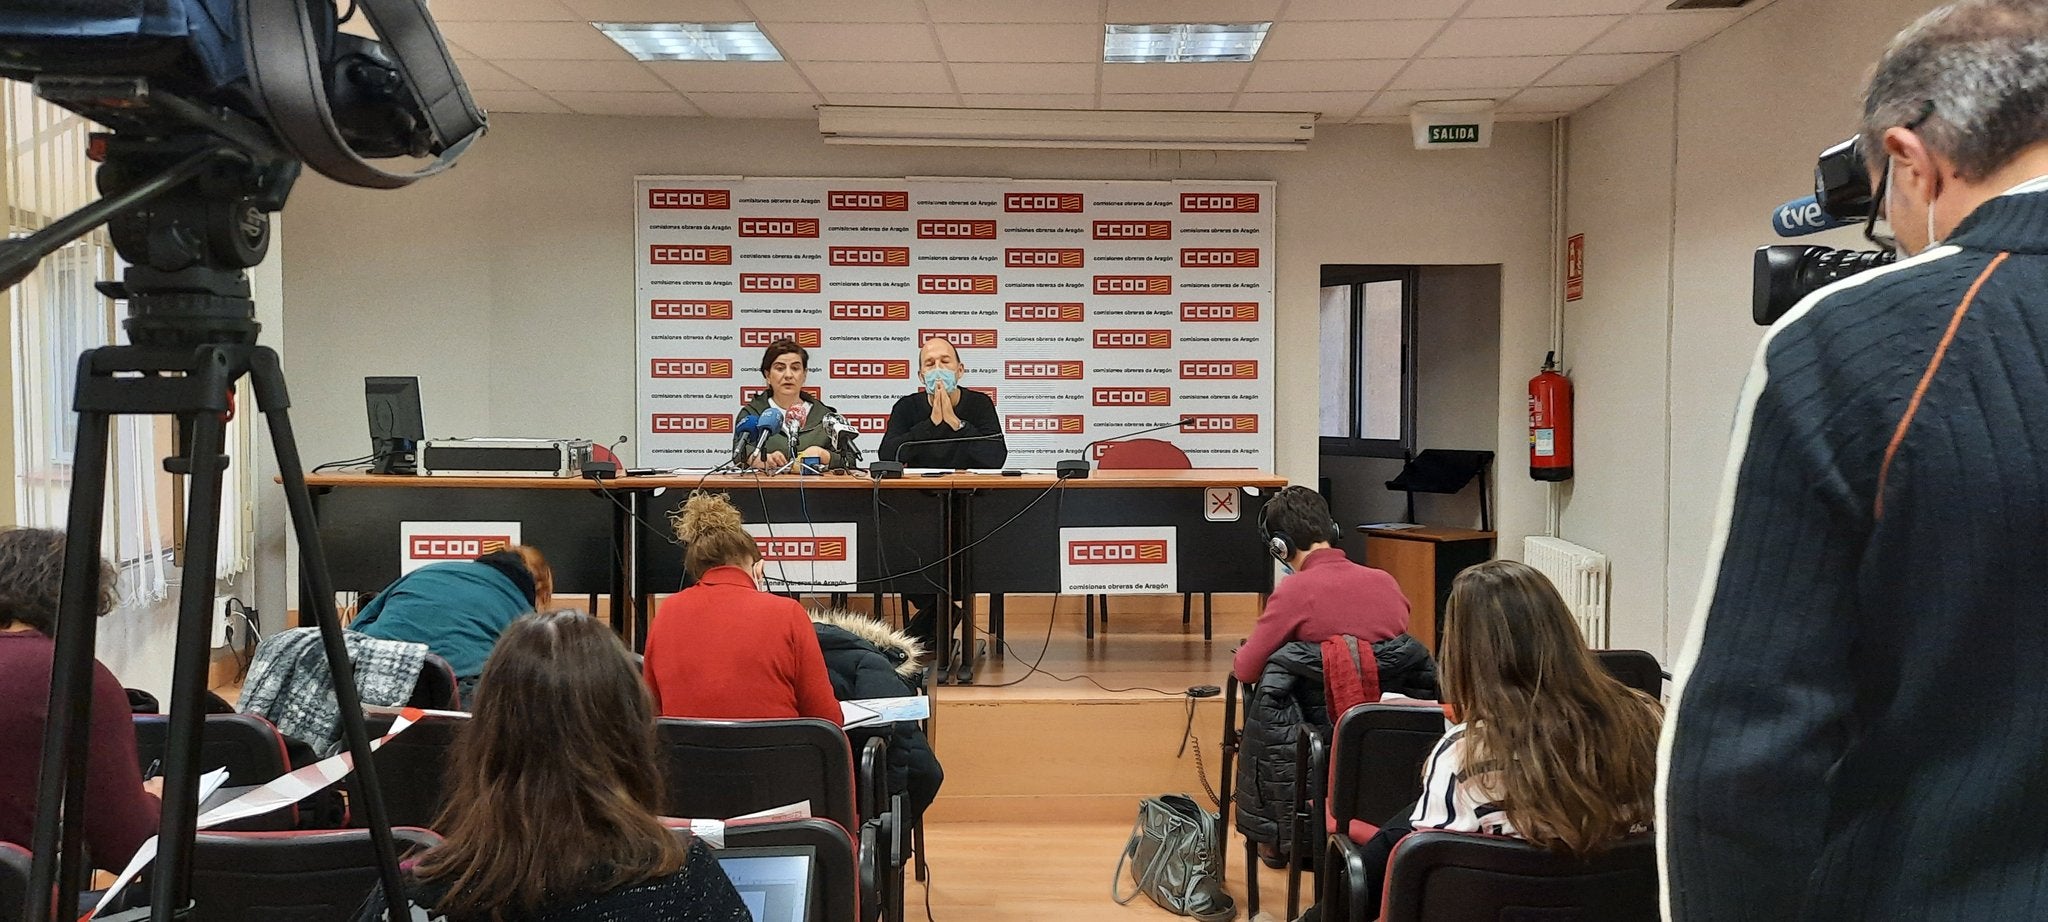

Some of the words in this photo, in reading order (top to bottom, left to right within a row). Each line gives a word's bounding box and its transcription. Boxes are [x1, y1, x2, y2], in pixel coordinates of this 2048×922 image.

[1433, 127, 1475, 140] SALIDA
[653, 193, 705, 205] CCOO
[832, 195, 883, 207] CCOO
[1008, 197, 1058, 209] CCOO
[1184, 197, 1234, 209] CCOO
[1779, 201, 1826, 230] tve
[743, 222, 794, 234] CCOO
[921, 223, 971, 235] CCOO
[1096, 224, 1146, 236] CCOO
[654, 249, 706, 261] CCOO
[833, 250, 884, 262] CCOO
[1009, 252, 1059, 264] CCOO
[1184, 252, 1234, 264] CCOO
[744, 277, 795, 289] CCOO
[922, 278, 972, 290] CCOO
[1096, 279, 1146, 291] CCOO
[655, 303, 707, 316] CCOO
[833, 305, 885, 317] CCOO
[1009, 306, 1059, 318] CCOO
[1184, 306, 1234, 318] CCOO
[1096, 333, 1147, 345] CCOO
[655, 362, 707, 375] CCOO
[833, 363, 885, 375] CCOO
[1009, 364, 1059, 376] CCOO
[1183, 364, 1233, 376] CCOO
[1096, 391, 1146, 403] CCOO
[656, 417, 708, 430] CCOO
[1009, 418, 1059, 430] CCOO
[414, 540, 479, 556] CCOO
[1073, 544, 1136, 560] CCOO
[1135, 582, 1143, 590] de
[1144, 582, 1169, 591] Aragón
